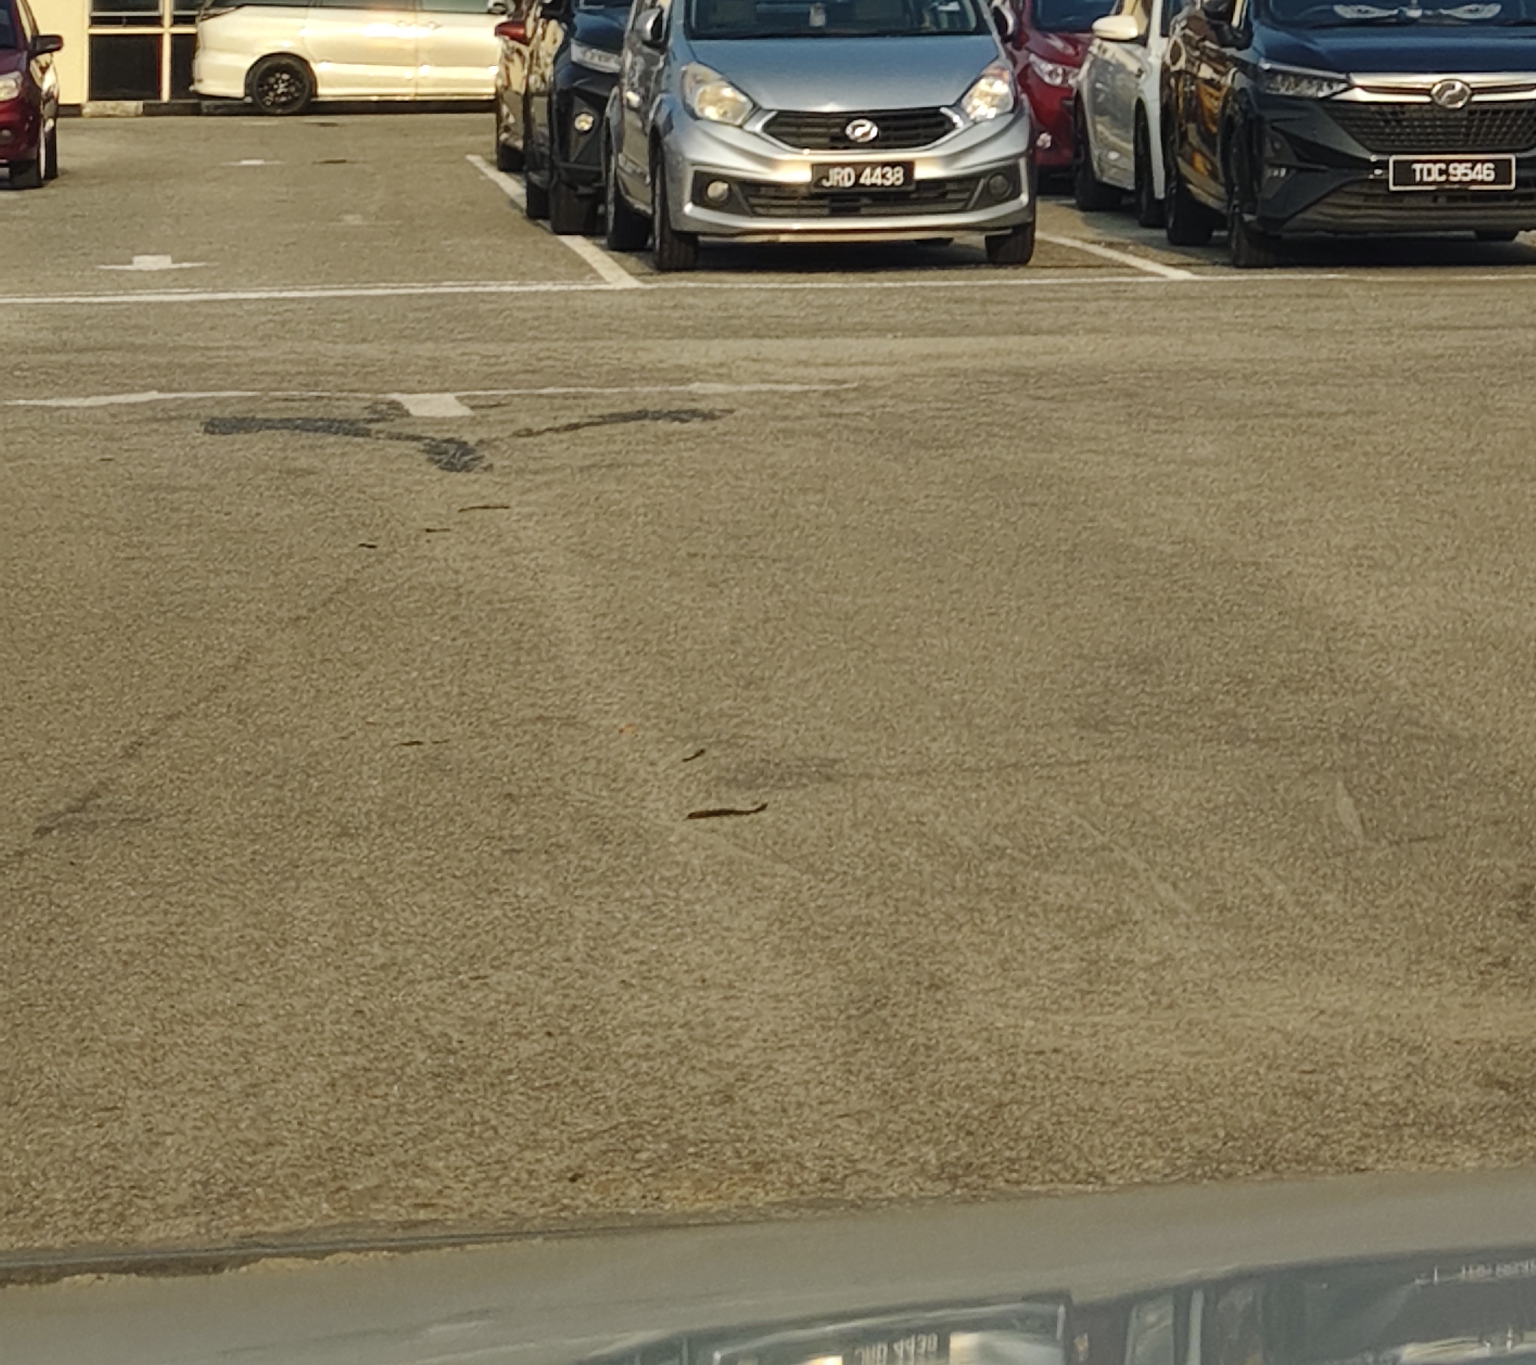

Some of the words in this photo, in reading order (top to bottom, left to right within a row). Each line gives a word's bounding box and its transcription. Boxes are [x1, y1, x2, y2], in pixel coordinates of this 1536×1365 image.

[822, 167, 855, 188] JRD
[859, 166, 904, 186] 4438
[1411, 163, 1447, 182] TDC
[1448, 163, 1495, 182] 9546
